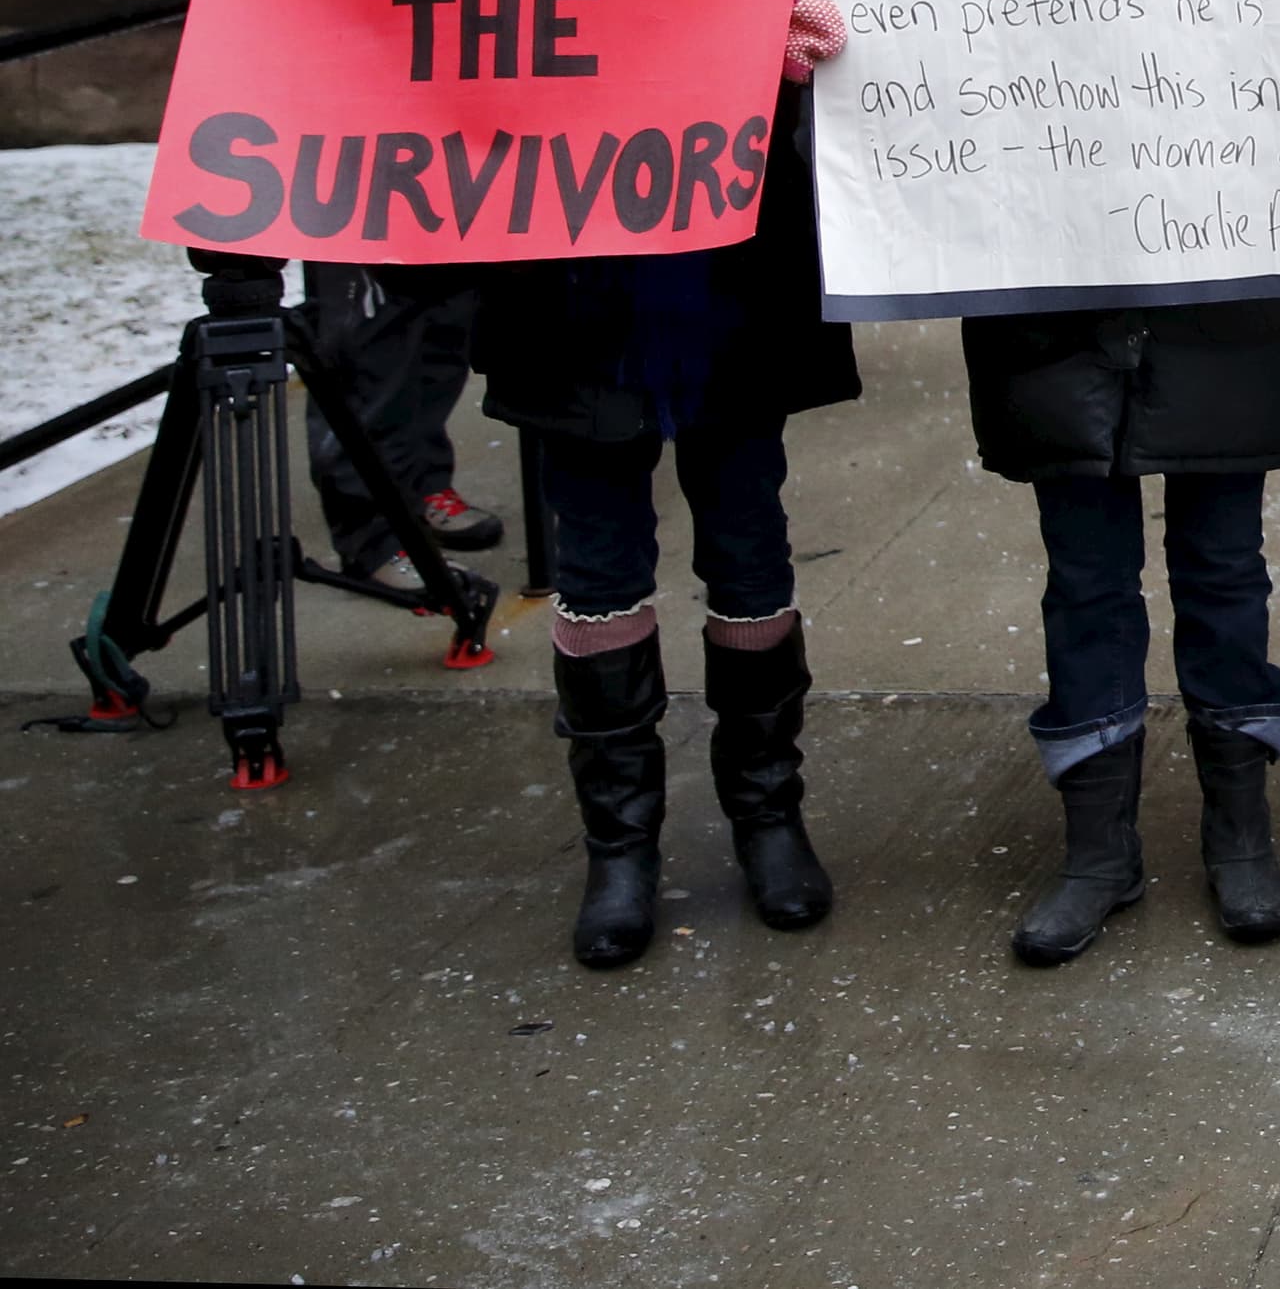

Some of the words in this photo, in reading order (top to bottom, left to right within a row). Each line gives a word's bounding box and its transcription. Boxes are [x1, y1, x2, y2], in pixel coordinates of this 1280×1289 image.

[850, 0, 938, 34] even
[861, 59, 936, 118] and
[958, 60, 1120, 117] somehow
[1131, 52, 1206, 111] this
[173, 111, 769, 246] SURVIVORS
[873, 139, 988, 180] issue
[1037, 124, 1107, 172] the
[1130, 134, 1256, 170] women
